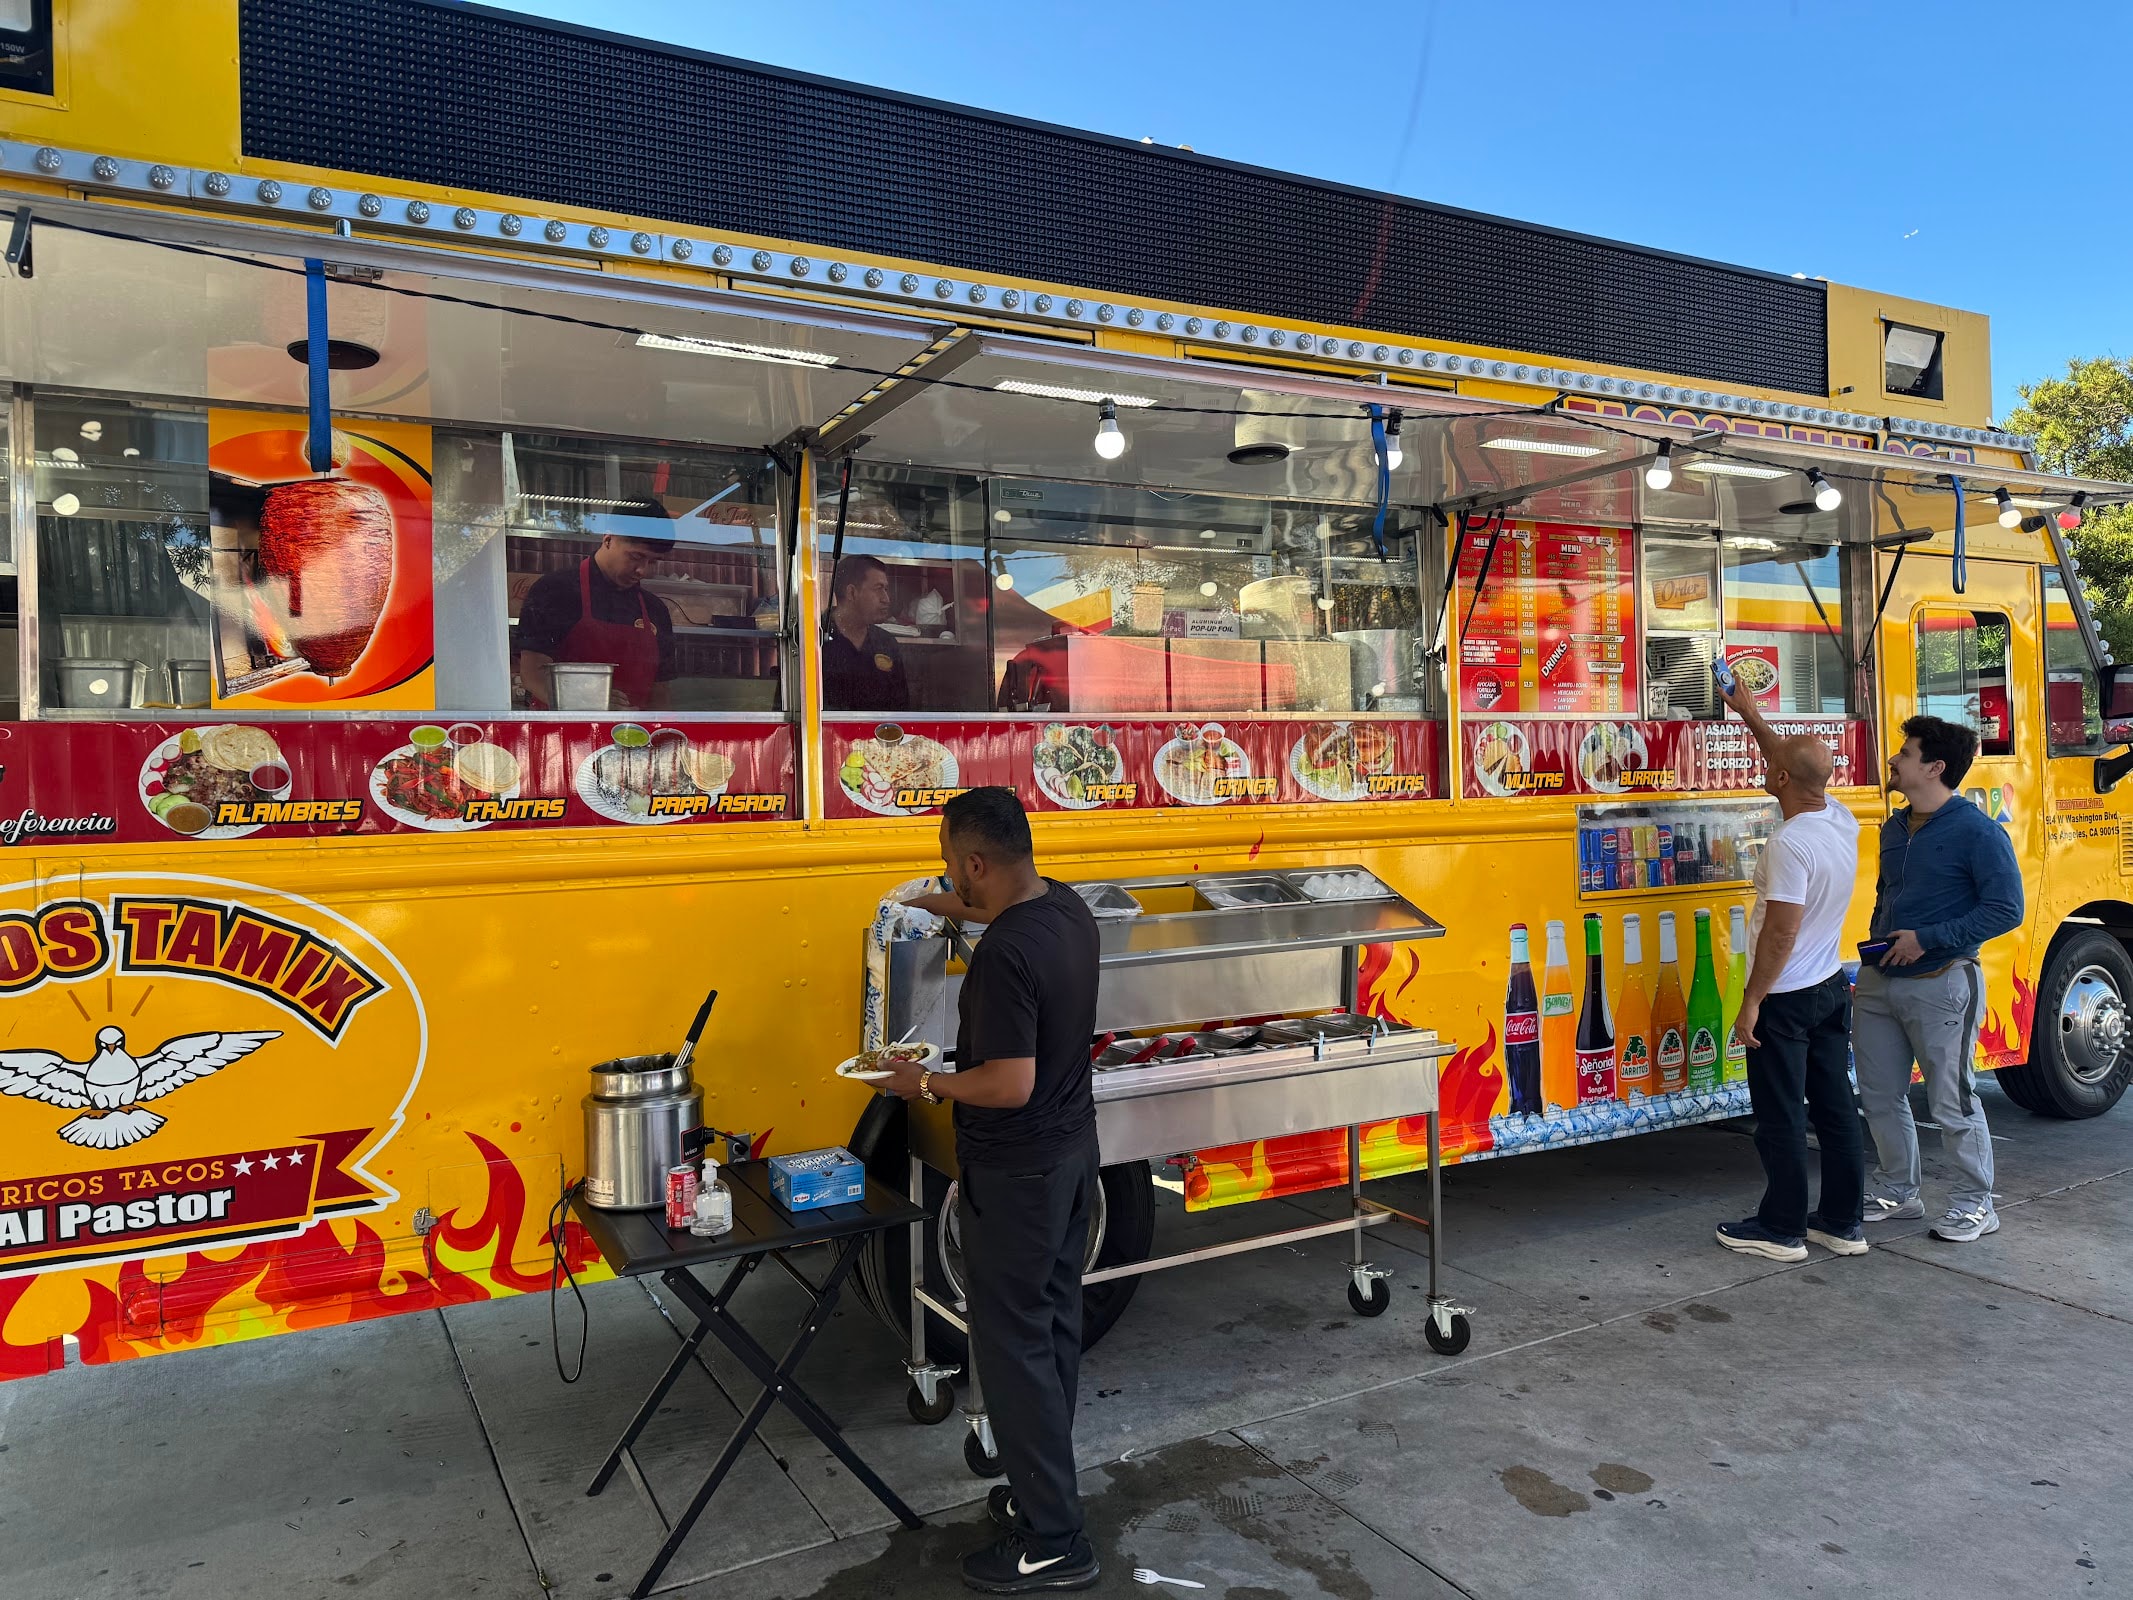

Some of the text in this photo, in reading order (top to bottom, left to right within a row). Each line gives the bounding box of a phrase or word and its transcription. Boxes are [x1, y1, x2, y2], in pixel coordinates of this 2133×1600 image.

[1473, 537, 1490, 546] MEN
[1561, 544, 1581, 553] MENU
[1661, 581, 1700, 601] Order
[1541, 640, 1568, 677] DRINKS
[1705, 725, 1741, 736] ASADA
[1813, 724, 1845, 735] POLLO
[1705, 740, 1747, 752] CABEZA
[1707, 757, 1752, 769] CHORIZO
[1213, 778, 1278, 796] GRINGA
[1366, 774, 1425, 793] TORTAS
[1504, 772, 1564, 789] MULITAS
[1619, 770, 1675, 787] BURRITOS
[1084, 783, 1137, 800] TACOS
[216, 799, 362, 824] ALAMBRES
[465, 798, 566, 821] FAJITAS
[650, 794, 787, 815] PAPA ASADA
[0, 808, 115, 844] eferencia
[2058, 815, 2064, 824] W
[2066, 812, 2103, 824] Washington
[2089, 828, 2099, 837] CA
[2100, 825, 2120, 837] 90015
[122, 900, 374, 1033] TAMIX
[1506, 1017, 1538, 1037] Coca-Cola
[1579, 1055, 1614, 1077] Señorial
[1661, 1054, 1682, 1064] JARRITOS
[1692, 1053, 1714, 1063] JARRITOS
[1621, 1063, 1649, 1076] JARRITOS
[1587, 1084, 1608, 1095] Sangria
[1, 1160, 226, 1202] RICOS TACOS
[0, 1188, 232, 1246] Al Pastor
